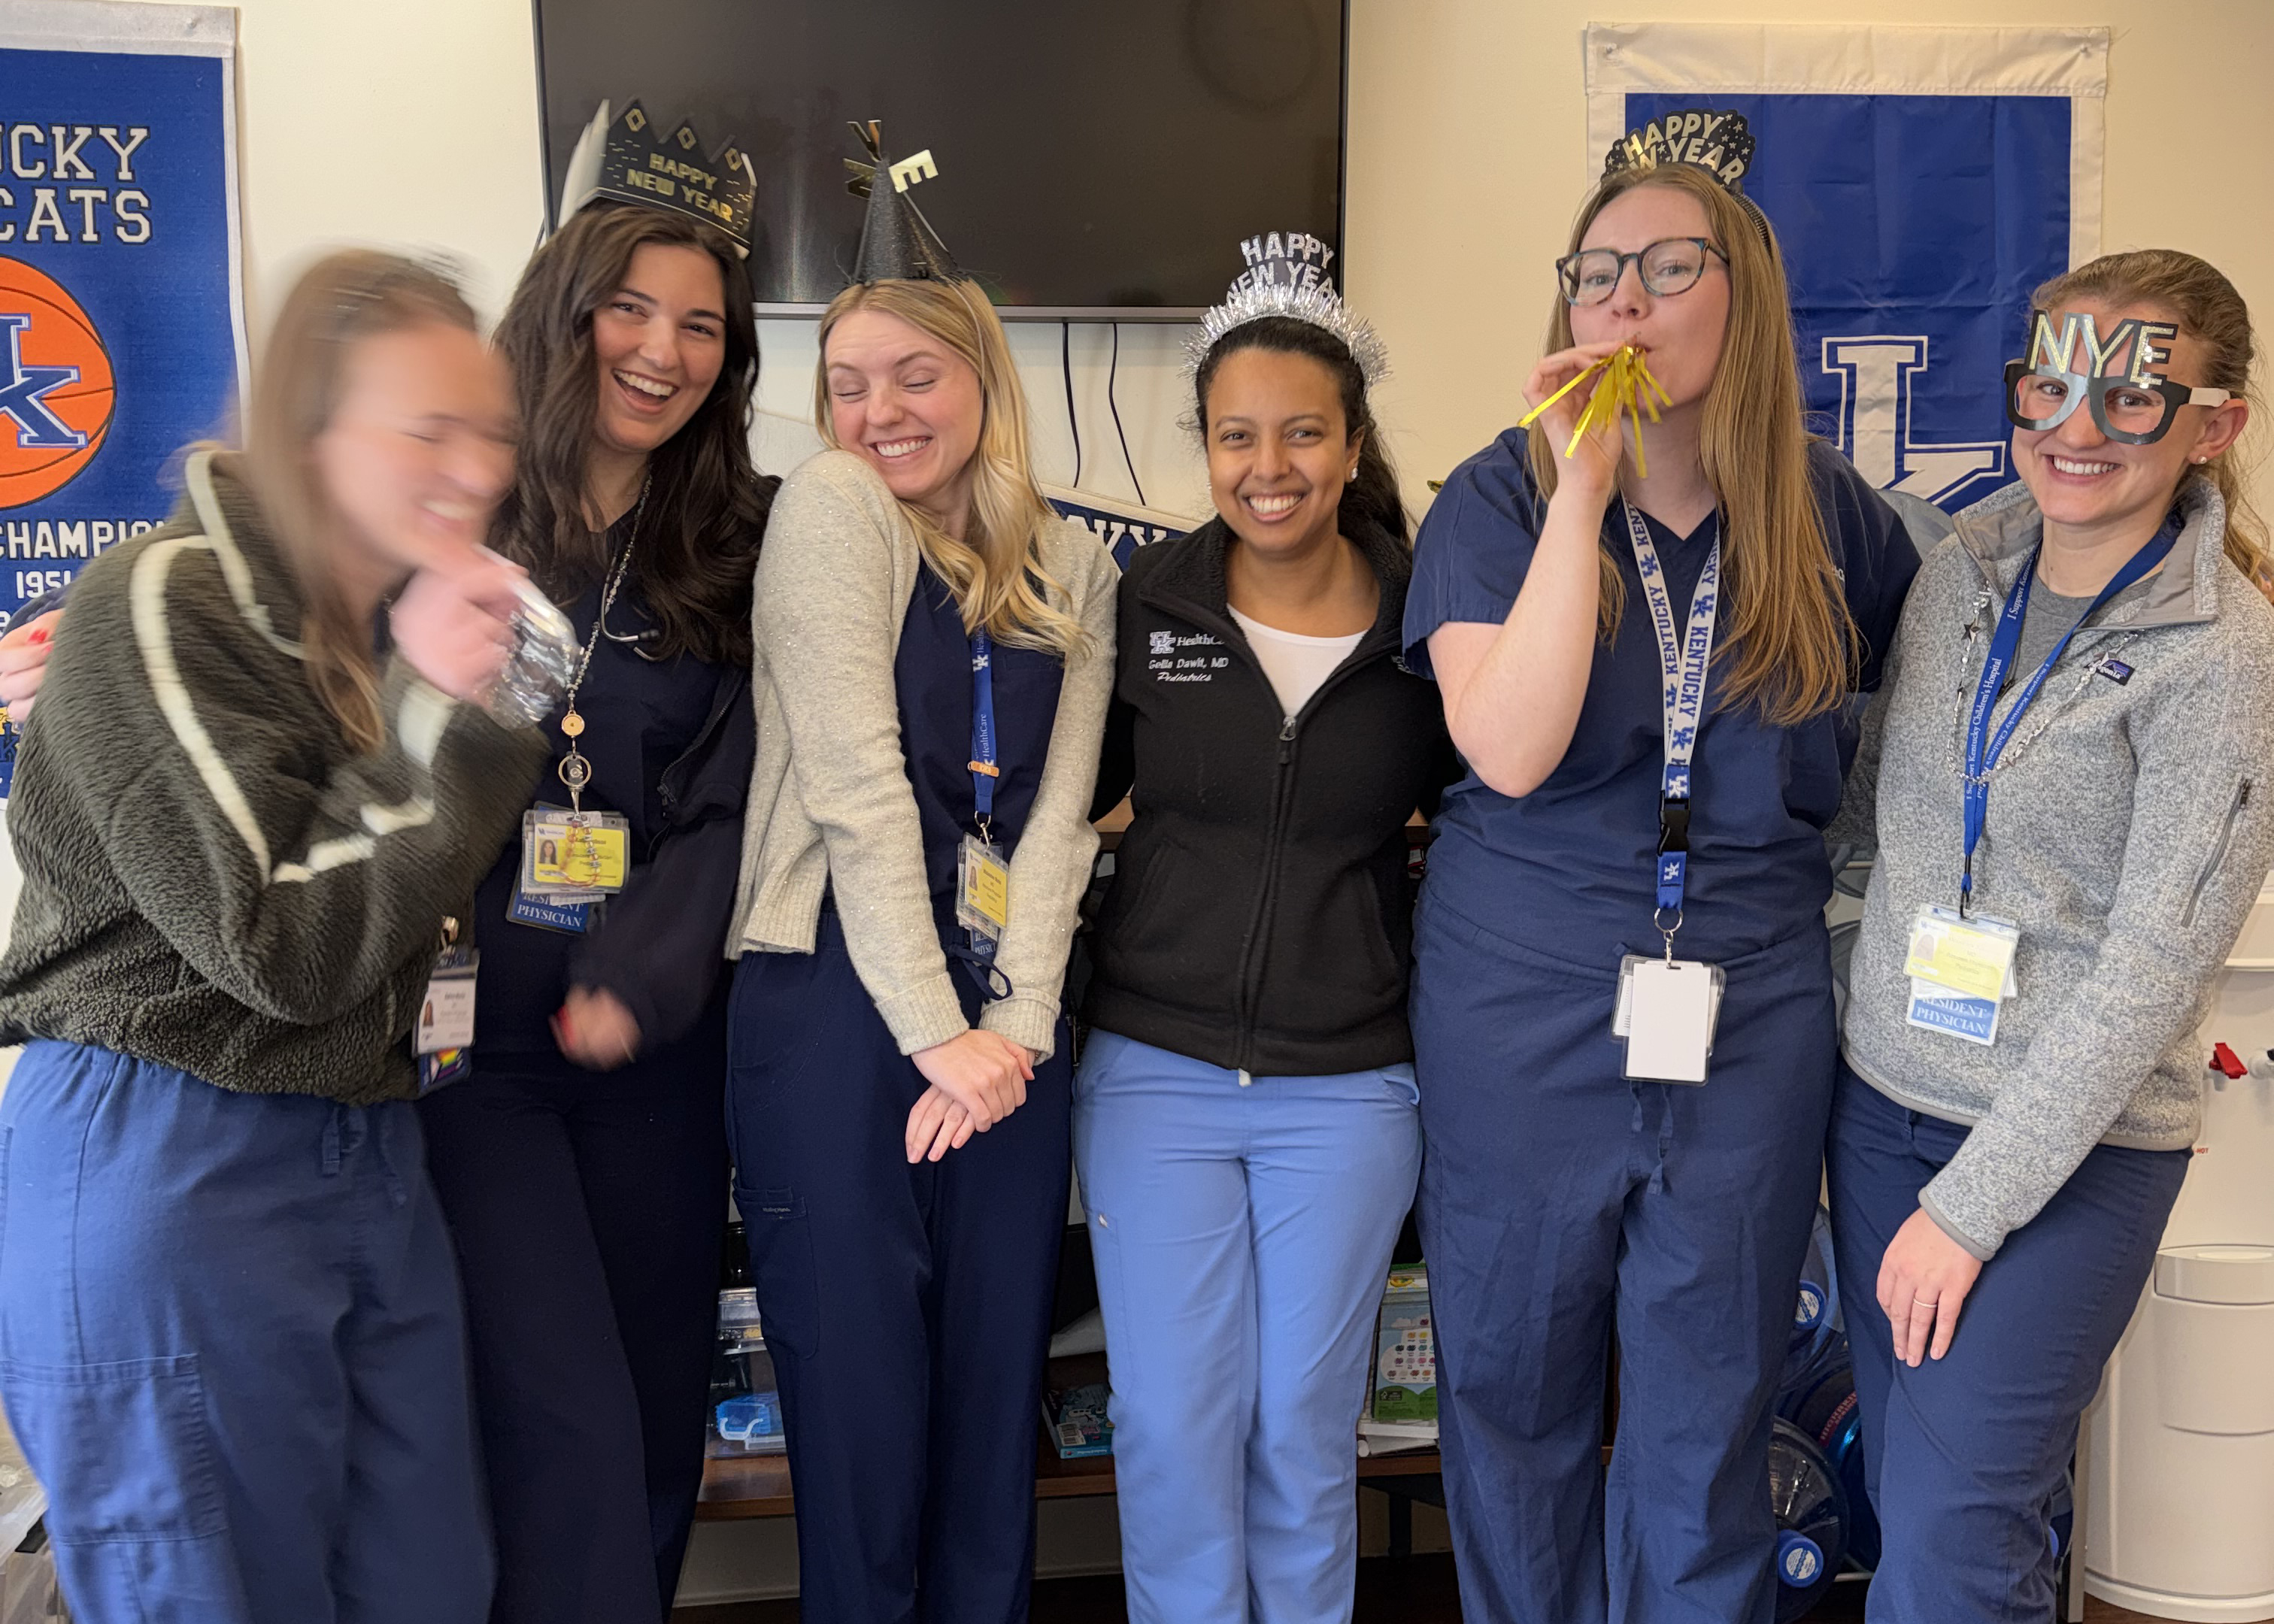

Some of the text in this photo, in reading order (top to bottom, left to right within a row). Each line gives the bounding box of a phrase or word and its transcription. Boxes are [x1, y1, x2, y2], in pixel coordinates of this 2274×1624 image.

[0, 123, 150, 181] CKY
[1622, 113, 1724, 162] HAPPY
[649, 153, 718, 191] HAPPY
[1668, 138, 1745, 185] YEAR
[626, 168, 733, 224] NEW YEAR
[1240, 230, 1336, 269] HAPPY
[2028, 314, 2175, 388] NYE
[1177, 632, 1225, 647] HealthC
[1648, 582, 1679, 675] KENTUCKY
[1211, 656, 1229, 668] MD
[1678, 625, 1709, 719] KENTUCKY
[1982, 657, 2003, 689] Hospital
[1972, 689, 1991, 726] Children's
[979, 714, 990, 757] HealthCare
[1968, 725, 1981, 762] Kentucky
[517, 904, 583, 927] PHYSICIAN
[1916, 1006, 1987, 1035] PHYSICIAN
